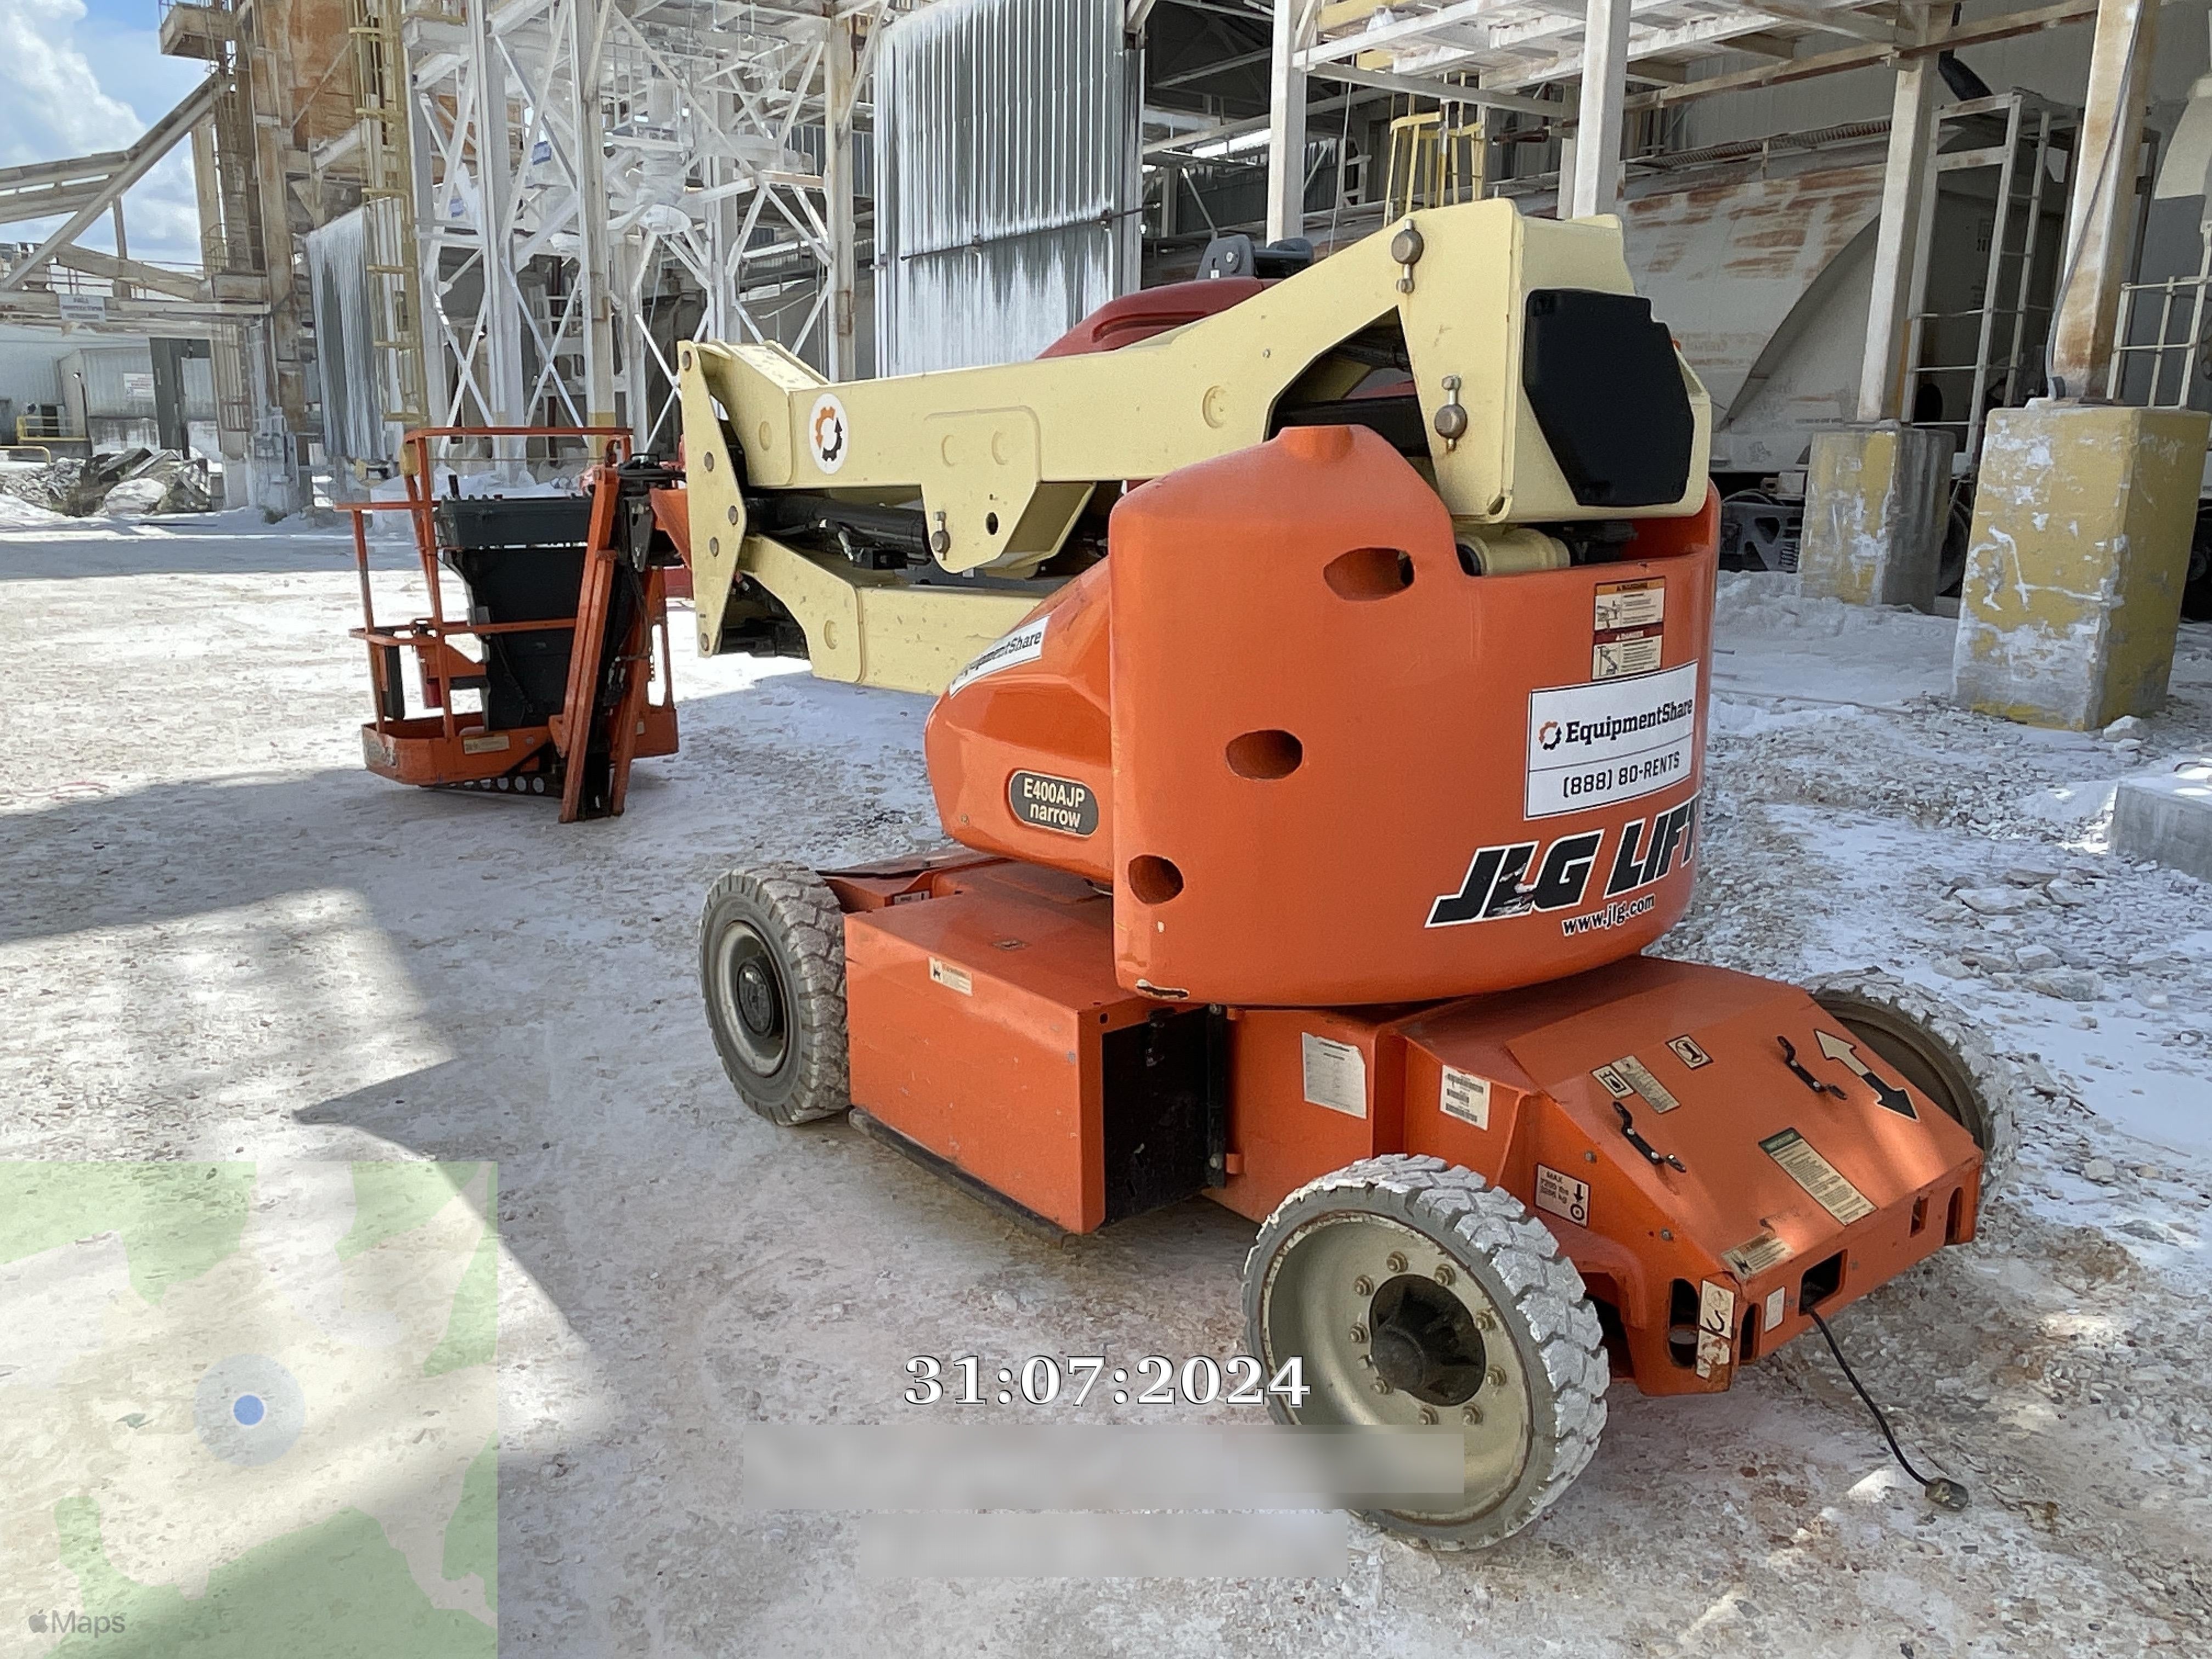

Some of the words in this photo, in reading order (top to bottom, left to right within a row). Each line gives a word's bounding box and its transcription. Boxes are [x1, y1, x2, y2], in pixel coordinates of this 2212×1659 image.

[1565, 699, 1693, 744] EquipmentShare
[1024, 777, 1085, 808] E400AJP
[1563, 769, 1613, 798] (888)
[1618, 751, 1680, 786] 80-RENTS
[1030, 803, 1081, 828] narrow
[1426, 830, 1604, 927] JLG
[1562, 894, 1654, 936] www.jlg.com
